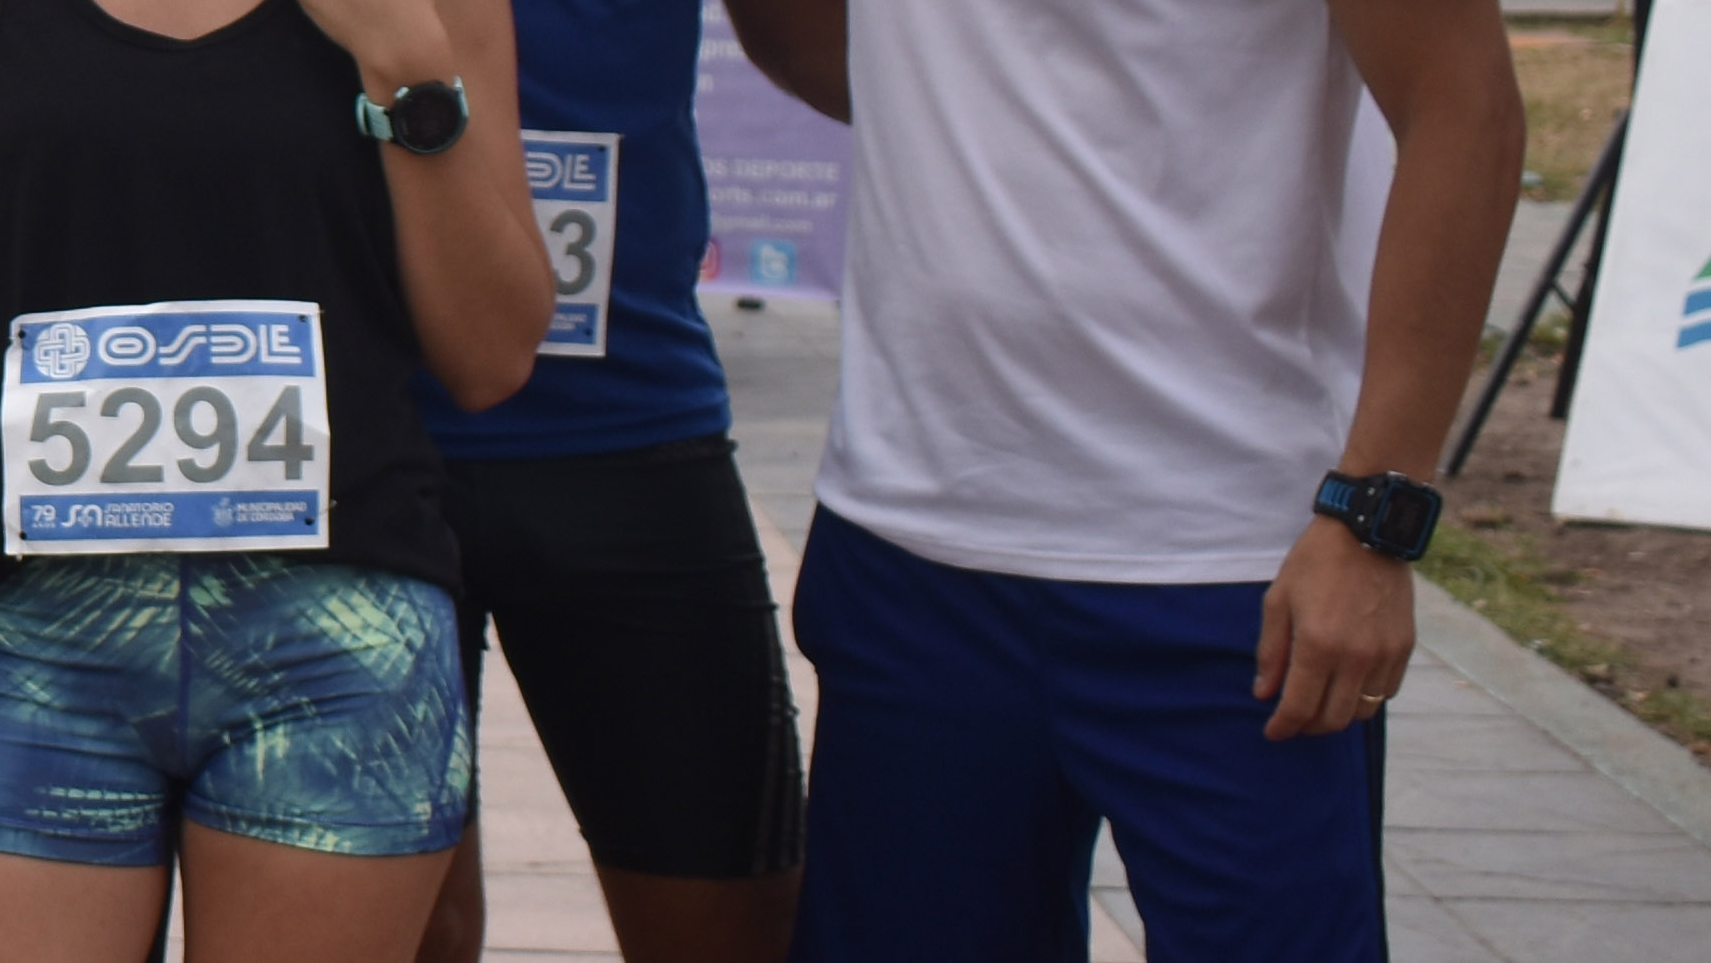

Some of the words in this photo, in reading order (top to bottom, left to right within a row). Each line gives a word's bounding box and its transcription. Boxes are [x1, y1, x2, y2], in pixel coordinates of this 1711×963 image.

[98, 324, 303, 366] OSDE
[28, 384, 315, 486] 5294
[31, 504, 57, 522] 79
[105, 513, 173, 527] ALLENDE
